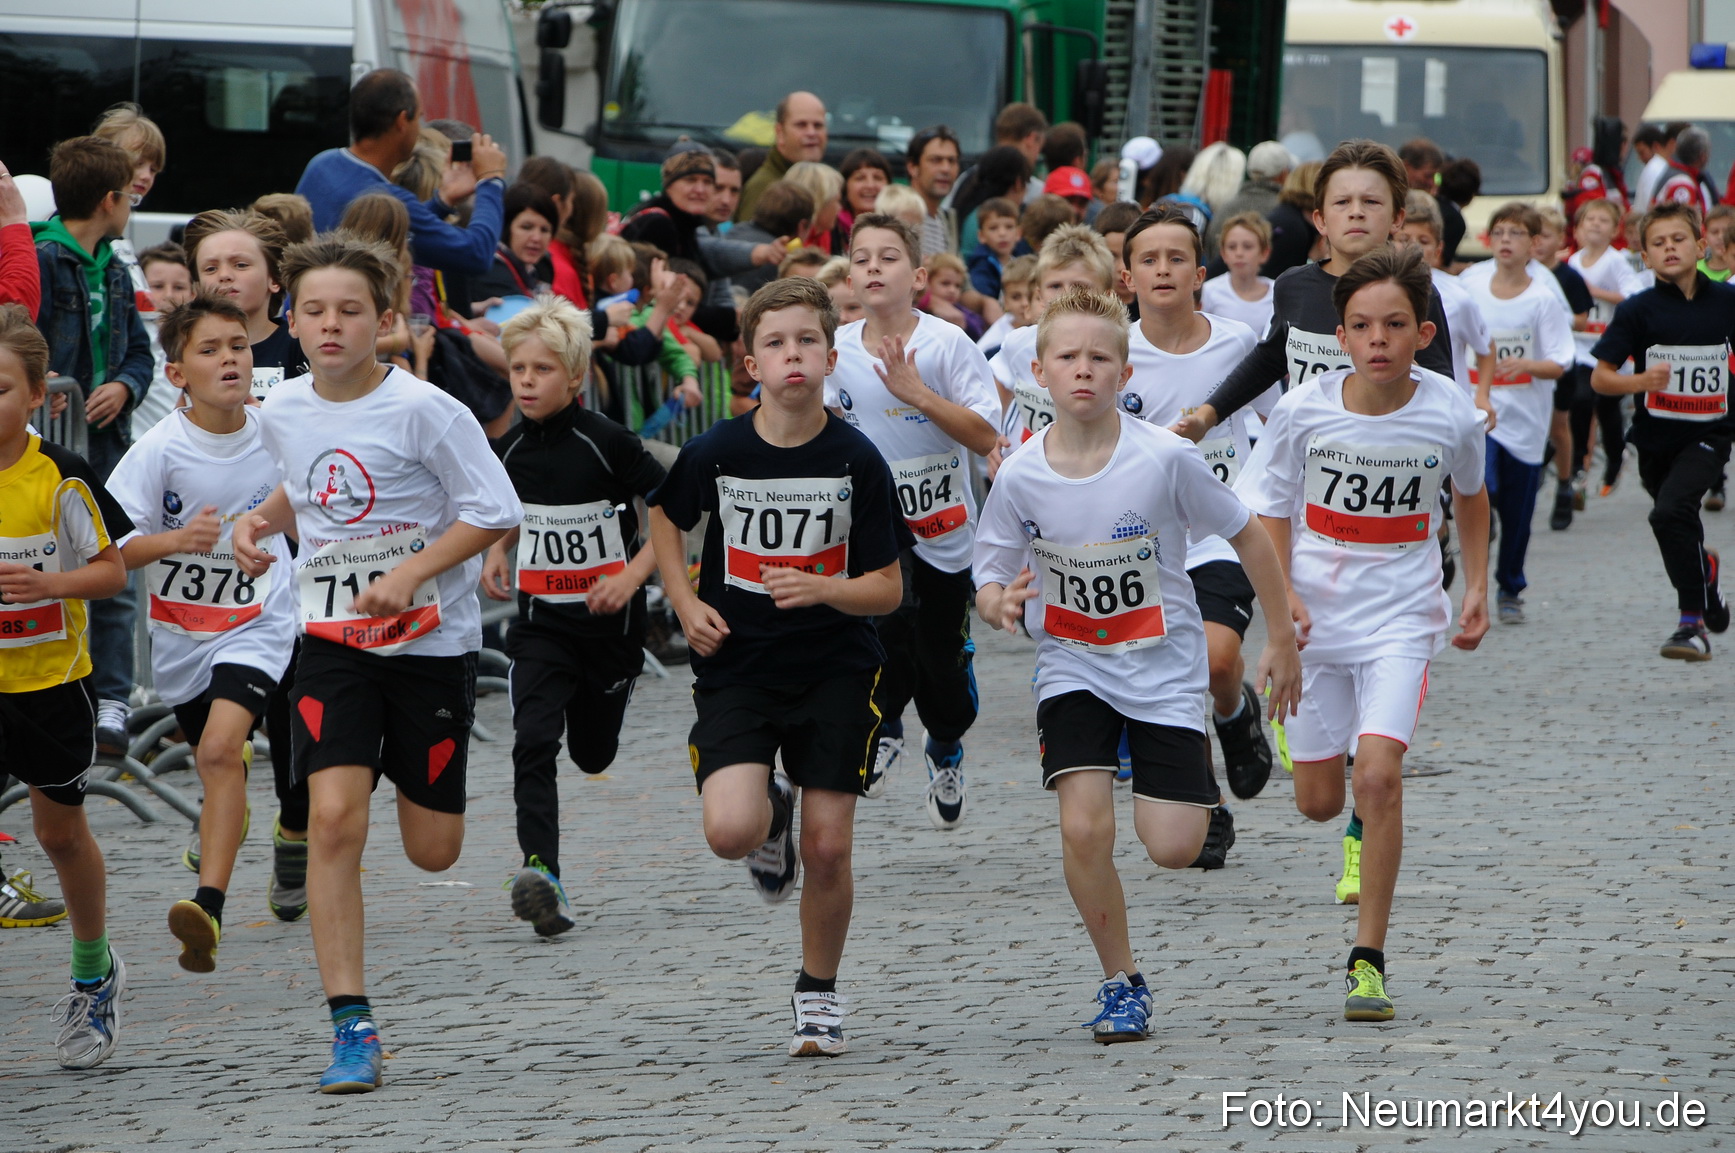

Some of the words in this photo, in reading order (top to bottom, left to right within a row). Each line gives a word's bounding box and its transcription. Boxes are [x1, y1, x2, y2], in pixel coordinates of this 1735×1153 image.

[1288, 338, 1314, 354] PARTL
[1317, 345, 1350, 357] Neum
[1648, 352, 1676, 361] PARTL
[1679, 353, 1718, 361] Neumarkt
[1674, 366, 1720, 394] 163
[1015, 388, 1040, 404] PARTL
[1655, 394, 1719, 411] Maximilian
[1023, 403, 1053, 432] 73
[1204, 450, 1222, 460] arkt
[1309, 447, 1352, 464] PARTL
[1356, 456, 1418, 468] Neumarkt
[900, 462, 948, 480] Neumarkt
[722, 485, 762, 502] PARTL
[766, 490, 832, 502] Neumarkt
[898, 474, 952, 516] 064
[1320, 466, 1422, 514] 7344
[523, 514, 544, 526] ARTL
[546, 512, 598, 526] Neumarkt
[734, 504, 834, 550] 7071
[1324, 514, 1360, 535] Morris
[0, 548, 38, 560] markt
[528, 524, 607, 565] 7081
[342, 546, 406, 565] Neumarkt
[1034, 548, 1068, 566] PARTL
[1069, 554, 1132, 569] Neumarkt
[159, 559, 256, 604] 7378
[546, 574, 598, 591] Fabian
[1049, 566, 1145, 615] 7386
[2, 620, 24, 634] as
[342, 620, 408, 646] Patrick
